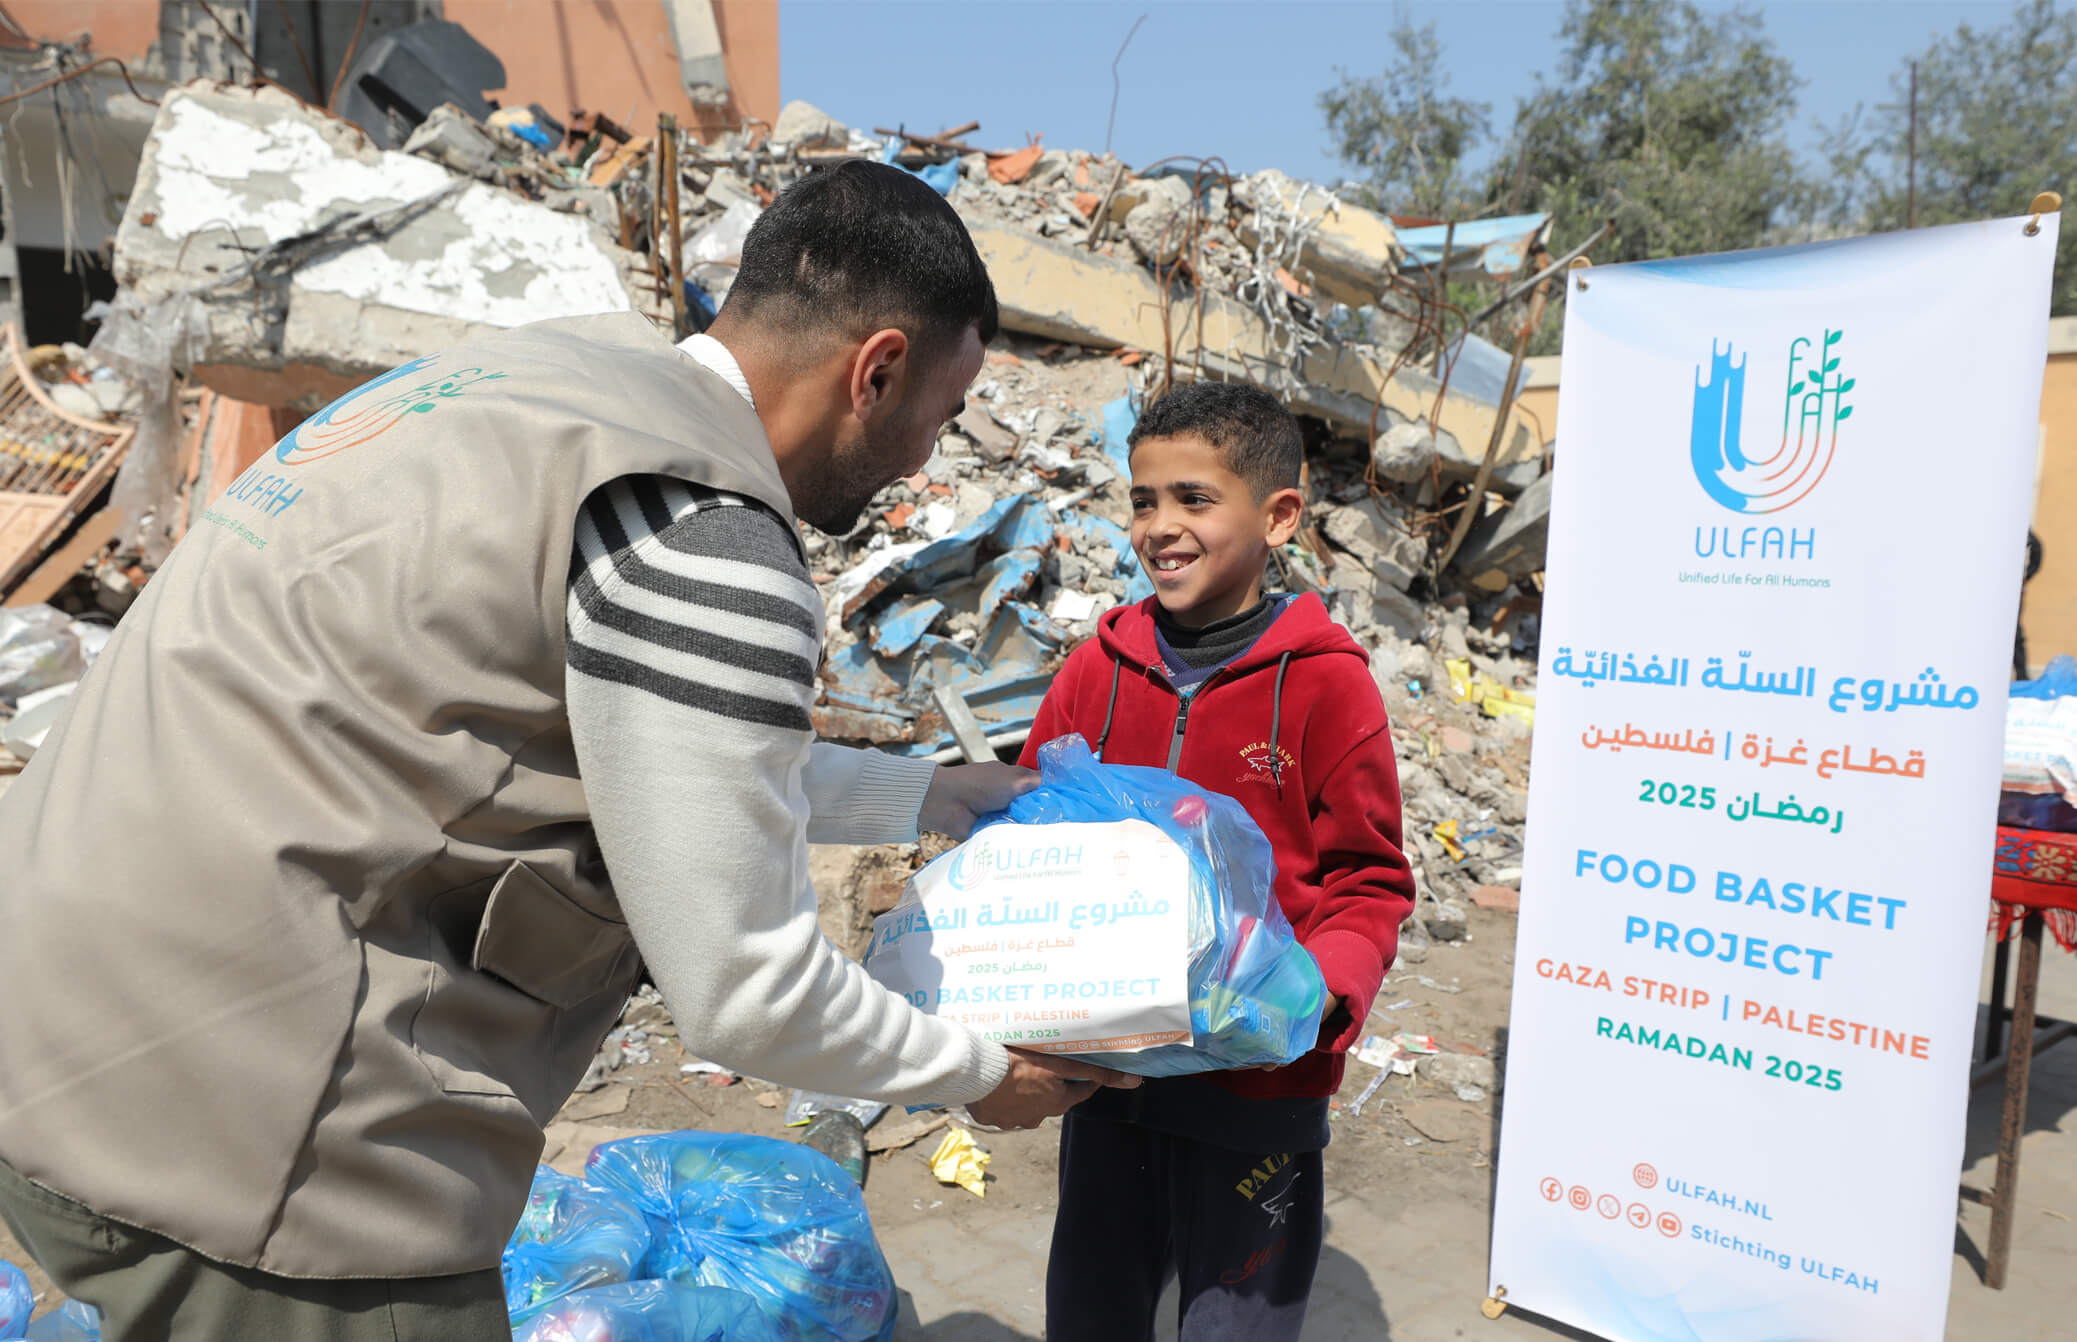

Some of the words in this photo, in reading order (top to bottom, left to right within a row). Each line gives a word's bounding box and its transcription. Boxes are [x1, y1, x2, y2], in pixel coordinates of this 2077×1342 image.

[226, 467, 304, 518] ULFAH
[1695, 526, 1816, 560] ULFAH
[1678, 571, 1720, 585] Unified
[1722, 572, 1743, 585] Life
[1745, 573, 1763, 586] For
[1765, 574, 1780, 586] All
[1783, 575, 1832, 589] Humans
[1829, 667, 1980, 712] مشروع
[1239, 742, 1260, 758] PAUL
[1268, 743, 1296, 767] ARK
[1582, 723, 1715, 754] فلسطين
[1741, 733, 1808, 767] غزة
[1817, 745, 1925, 778] قطاع
[1639, 780, 1717, 810] 2025
[1726, 792, 1844, 834] رمضان
[996, 844, 1083, 871] ULFAH
[1575, 849, 1697, 895] FOOD
[1714, 872, 1908, 931] BASKET
[1069, 889, 1170, 930] مشروع
[944, 940, 998, 957] فلسطين
[1624, 915, 1833, 981] PROJECT
[967, 962, 999, 974] 2025
[1002, 961, 1047, 976] رمضان
[937, 984, 1035, 1005] BASKET
[1043, 977, 1161, 1001] PROJECT
[961, 1012, 1001, 1025] STRIP
[1013, 1009, 1090, 1022] PALESTINE
[1536, 958, 1612, 991] GAZA
[1623, 976, 1710, 1009] STRIP
[1743, 1000, 1931, 1060] PALESTINE
[981, 1030, 1023, 1041] ADAN
[1027, 1028, 1061, 1039] 2025
[1596, 1015, 1753, 1071] RAMADAN
[1764, 1055, 1843, 1092] 2025
[1666, 1177, 1773, 1221] ULFAH.NL
[1690, 1224, 1792, 1270] Stichting
[1800, 1257, 1880, 1294] ULFAH
